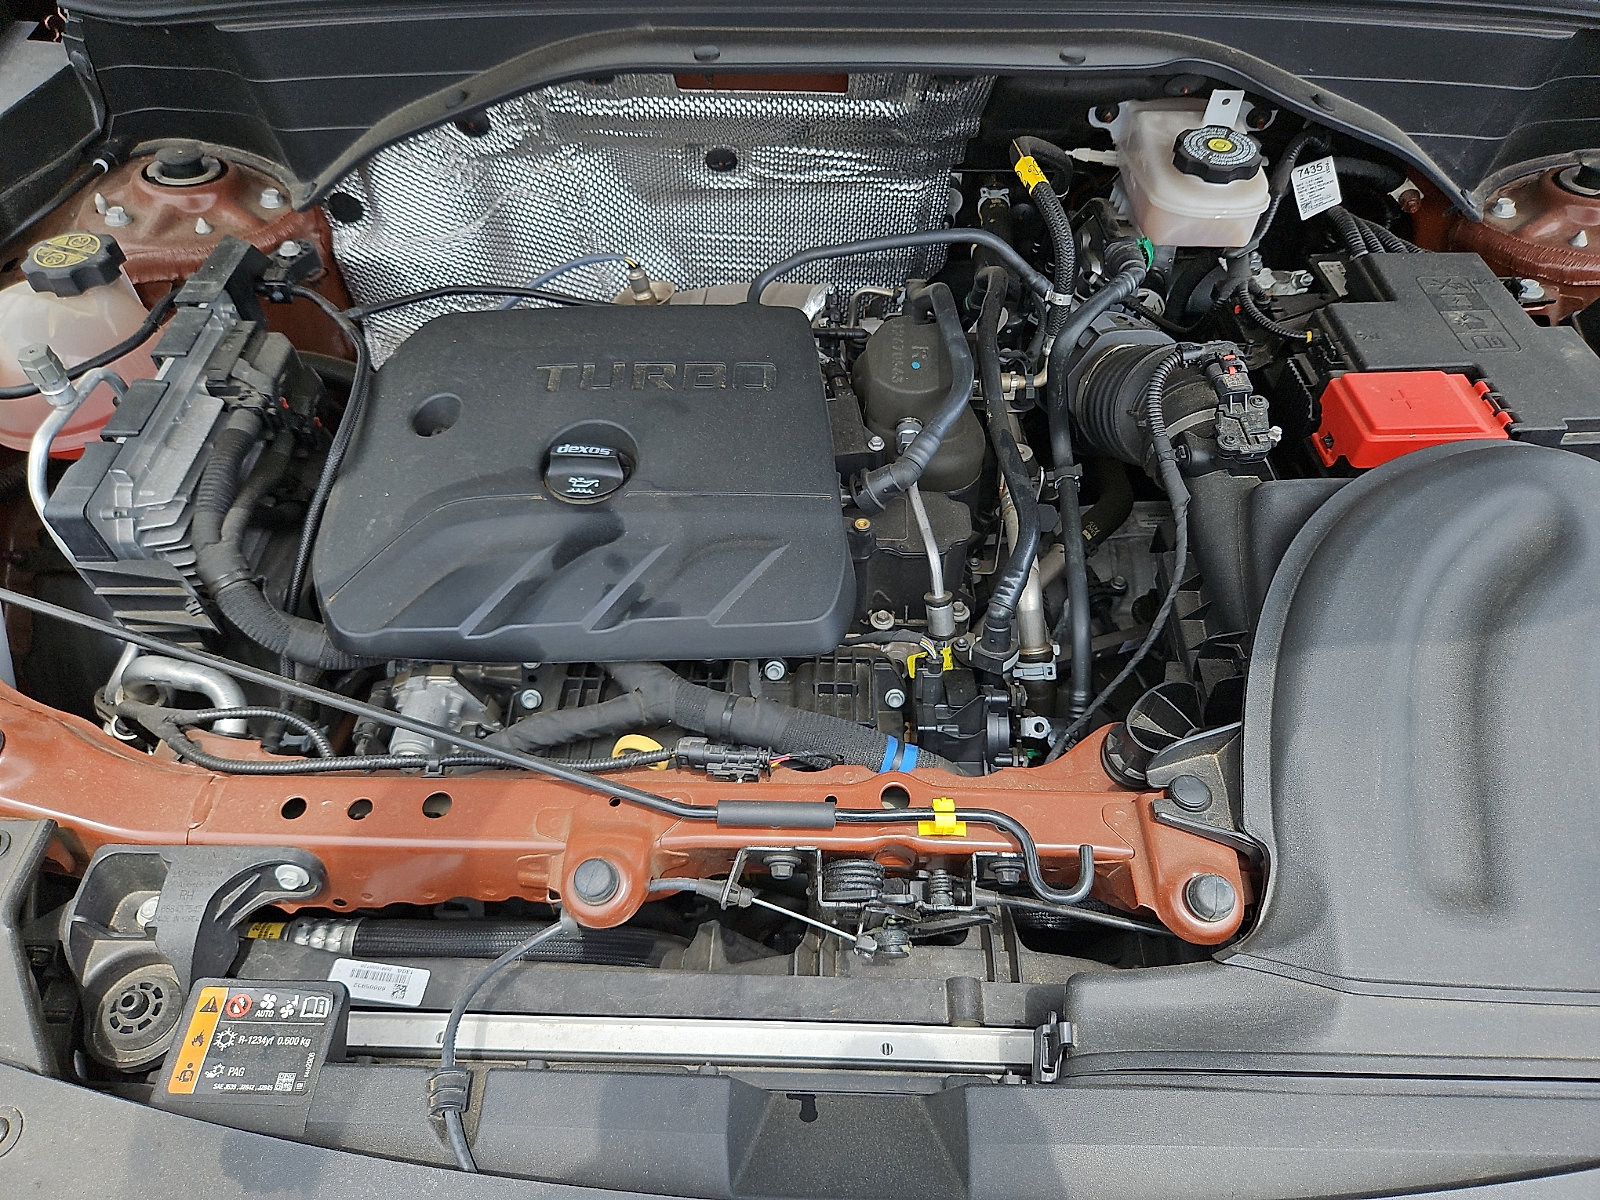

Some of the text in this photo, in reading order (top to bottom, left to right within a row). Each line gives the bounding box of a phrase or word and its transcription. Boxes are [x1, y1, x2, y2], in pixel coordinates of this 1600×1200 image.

[1298, 163, 1323, 178] 7435
[536, 361, 777, 392] TURBO
[556, 443, 613, 456] dexos
[179, 889, 195, 901] RH
[255, 1009, 274, 1018] AUTO
[237, 1035, 311, 1048] R-1234yf 0.600 kg
[227, 1066, 245, 1077] PAG
